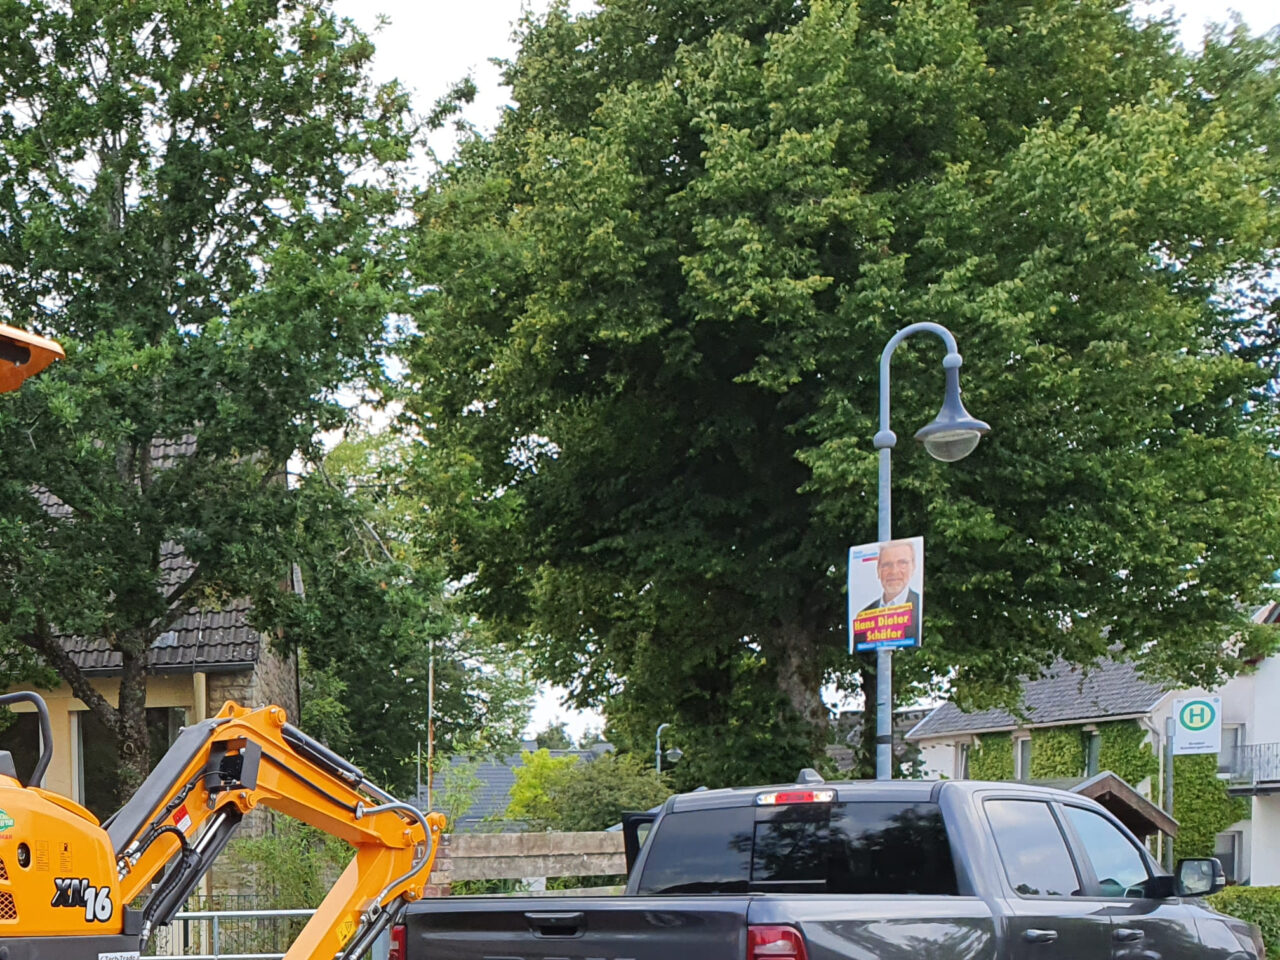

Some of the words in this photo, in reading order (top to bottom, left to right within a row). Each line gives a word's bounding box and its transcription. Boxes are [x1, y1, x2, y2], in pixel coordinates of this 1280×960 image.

[854, 620, 875, 631] Hans
[878, 615, 909, 627] Dieter
[866, 628, 902, 641] Schäfer
